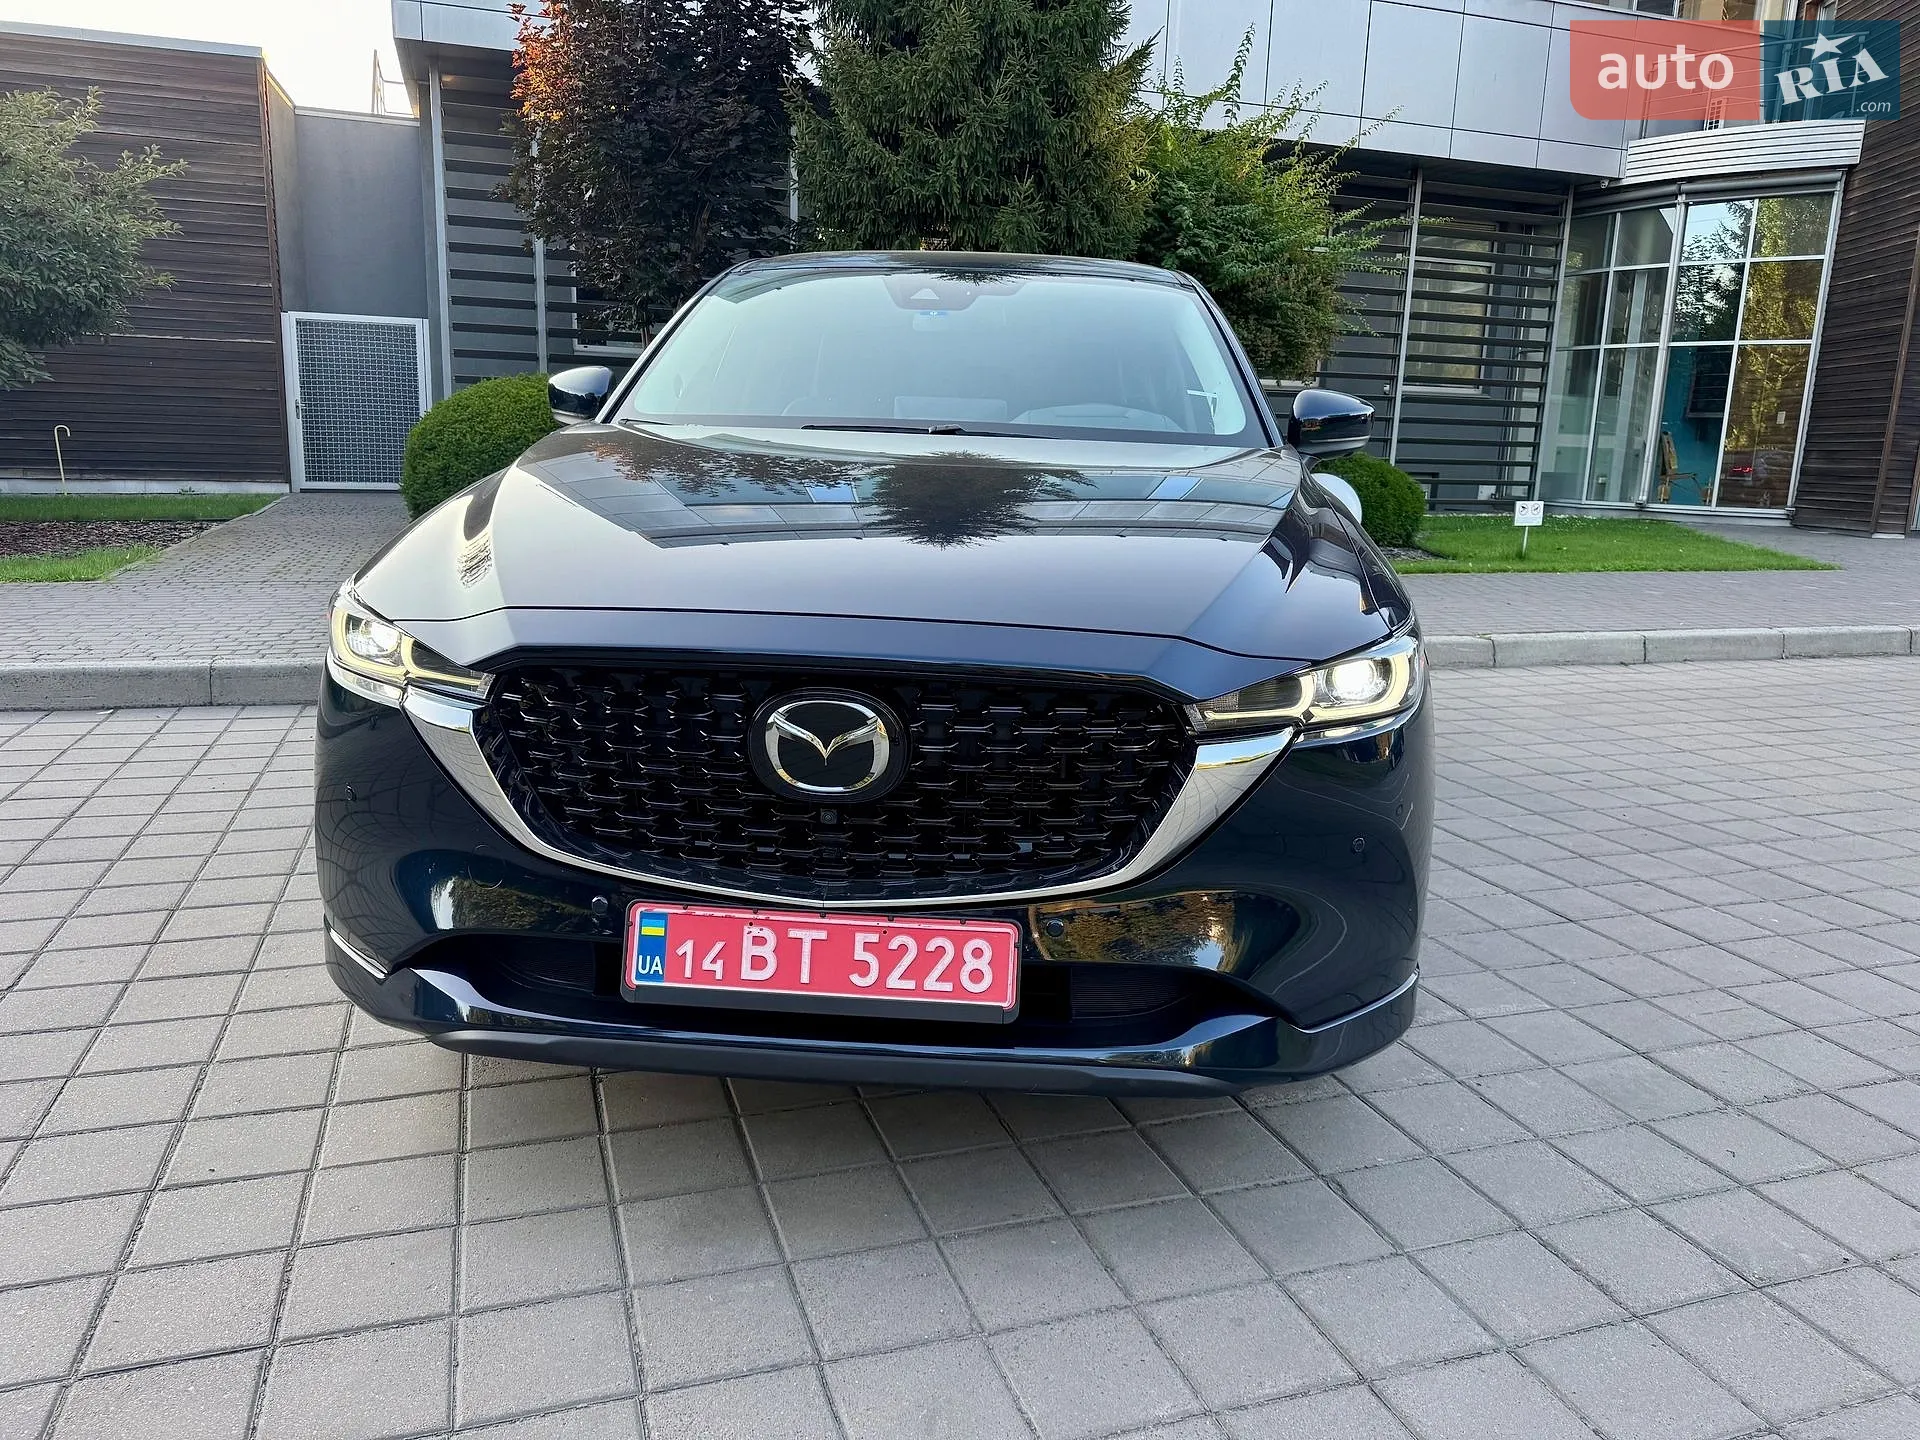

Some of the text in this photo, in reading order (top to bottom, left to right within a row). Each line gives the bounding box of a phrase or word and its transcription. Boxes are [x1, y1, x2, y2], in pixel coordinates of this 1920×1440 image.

[637, 955, 664, 975] UA
[675, 925, 993, 994] 14 BT 5228
